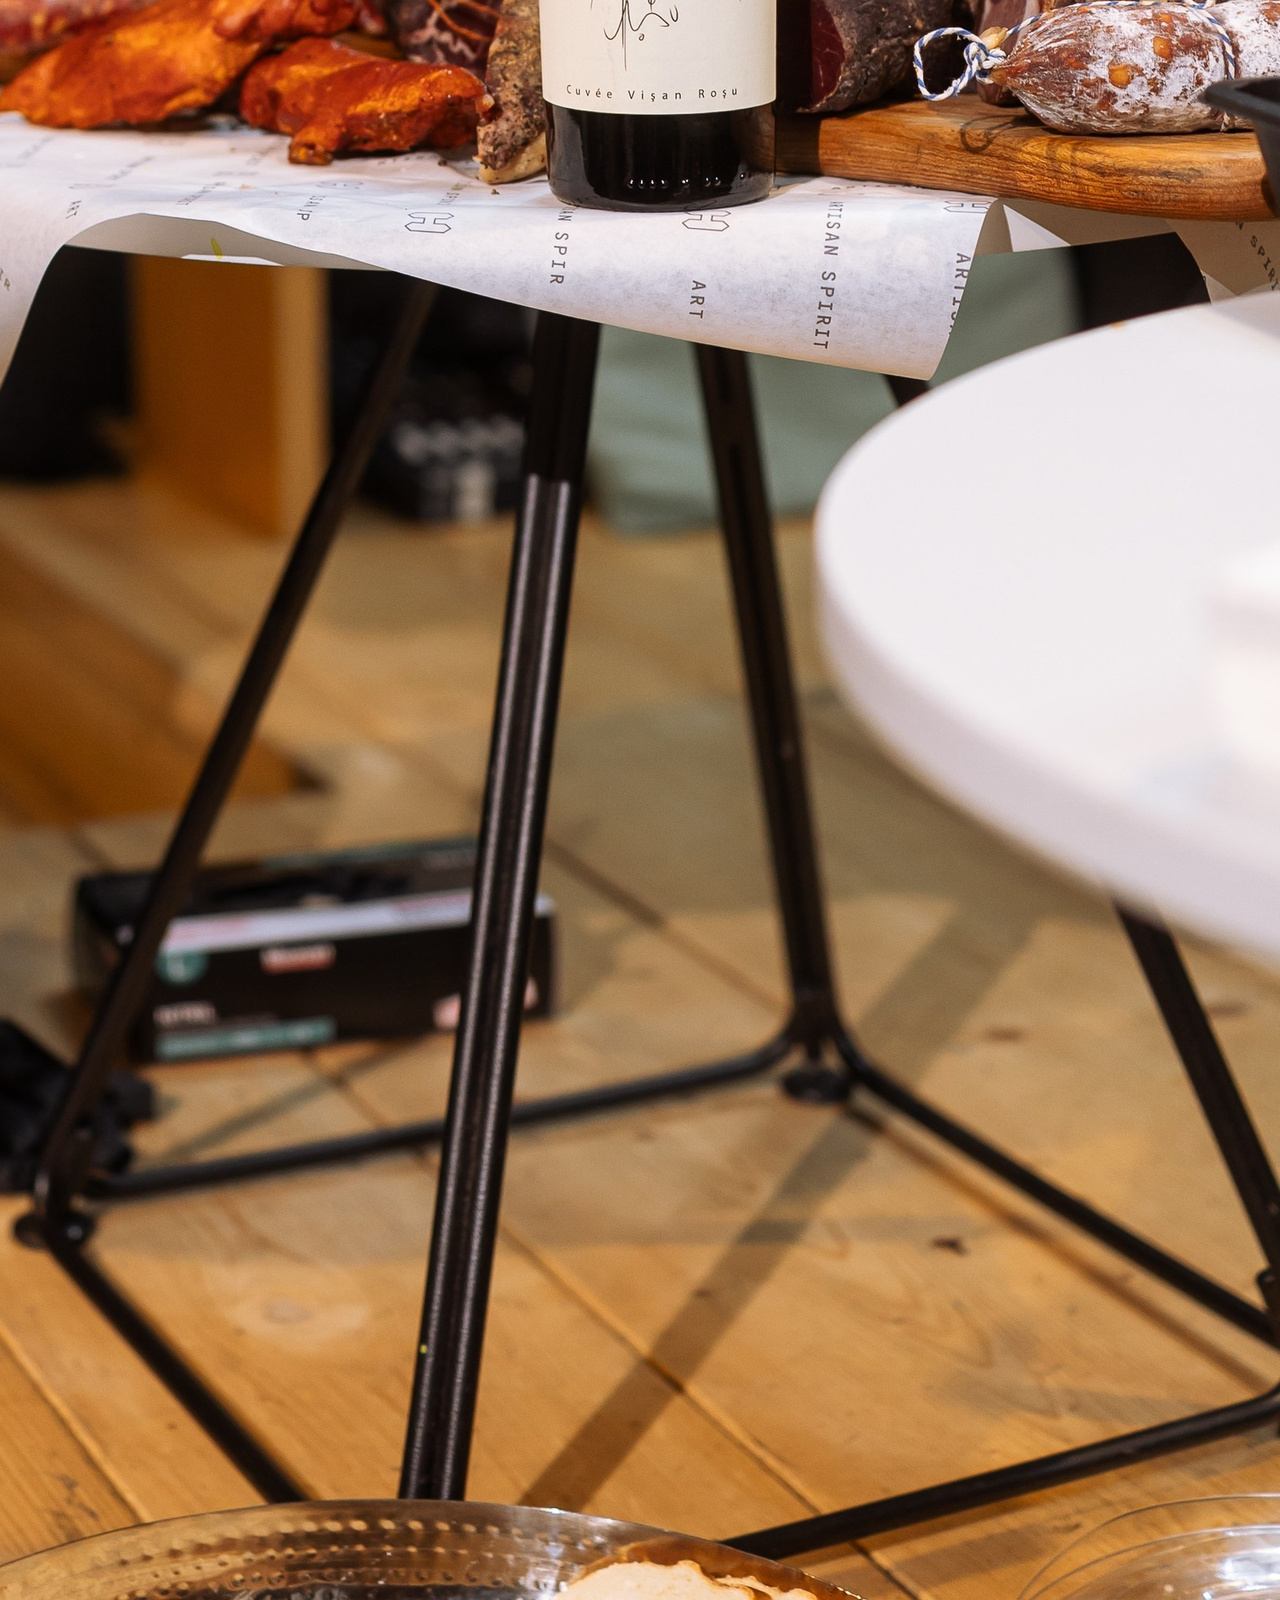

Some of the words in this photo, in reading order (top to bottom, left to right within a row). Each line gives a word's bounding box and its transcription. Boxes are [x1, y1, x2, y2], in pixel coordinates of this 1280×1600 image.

[566, 84, 613, 99] Cuvée
[550, 232, 570, 284] SPIR
[689, 280, 707, 319] ART
[813, 271, 837, 349] SPIRIT
